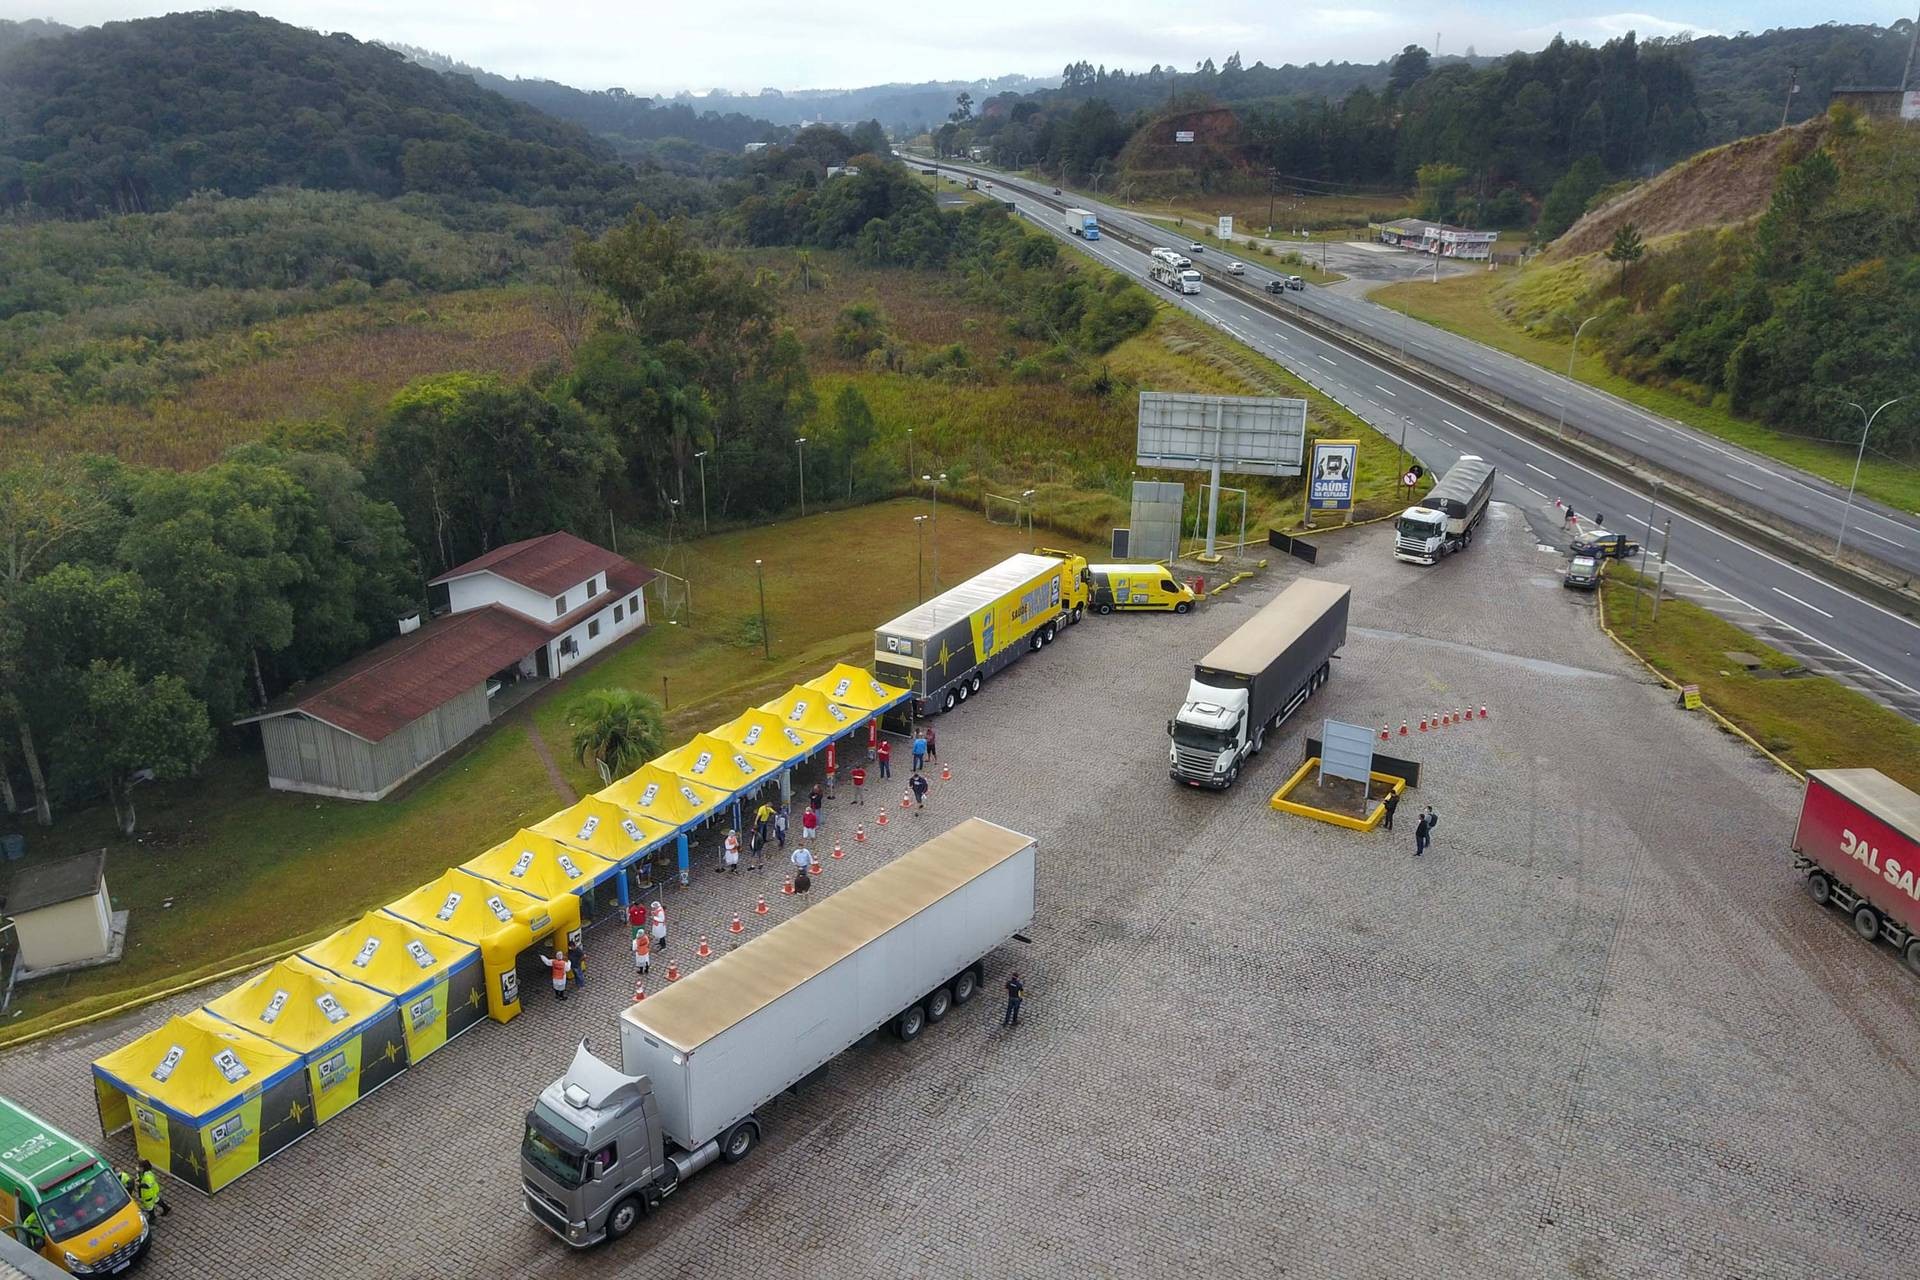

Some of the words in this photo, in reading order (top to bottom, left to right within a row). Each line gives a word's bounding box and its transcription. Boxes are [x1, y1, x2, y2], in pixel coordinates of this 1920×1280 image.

[1314, 481, 1348, 492] SAÚDE
[1840, 828, 1881, 875] DAL
[2, 1133, 45, 1159] AC-10
